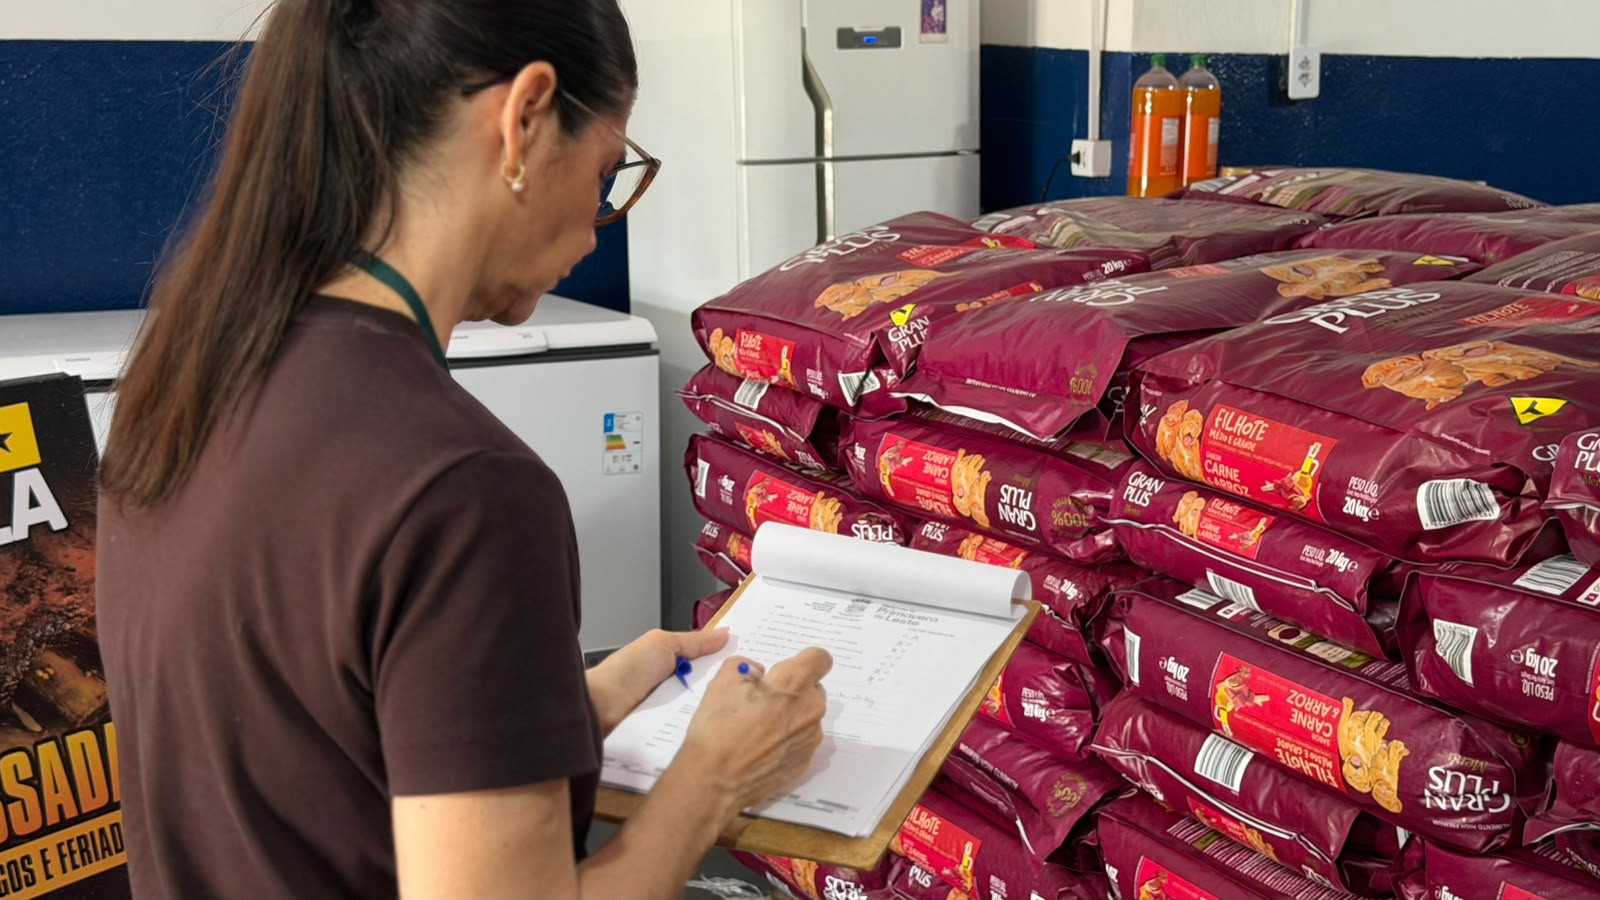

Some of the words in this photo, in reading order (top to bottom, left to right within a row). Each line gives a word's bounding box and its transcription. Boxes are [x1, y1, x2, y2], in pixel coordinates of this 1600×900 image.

[1309, 290, 1441, 335] PLUS
[888, 315, 930, 343] GRAN
[1214, 407, 1269, 442] FILHOTE
[921, 462, 949, 480] CARNE
[1127, 470, 1165, 494] GRAN
[1204, 459, 1241, 483] CARNE
[1347, 476, 1366, 492] PESO
[1000, 483, 1032, 510] PLUS
[1122, 485, 1153, 508] PLUS
[997, 502, 1036, 532] GRAN
[1051, 509, 1089, 528] 100%
[1526, 647, 1559, 679] 20kg
[1285, 689, 1332, 717] ARROZ
[1533, 682, 1554, 702] PESO
[1289, 707, 1334, 738] CARNE
[1331, 706, 1340, 719] &
[1273, 747, 1339, 789] FILHOTE
[1428, 765, 1499, 796] PLUS
[1422, 787, 1511, 814] GRAN
[40, 847, 54, 881] E
